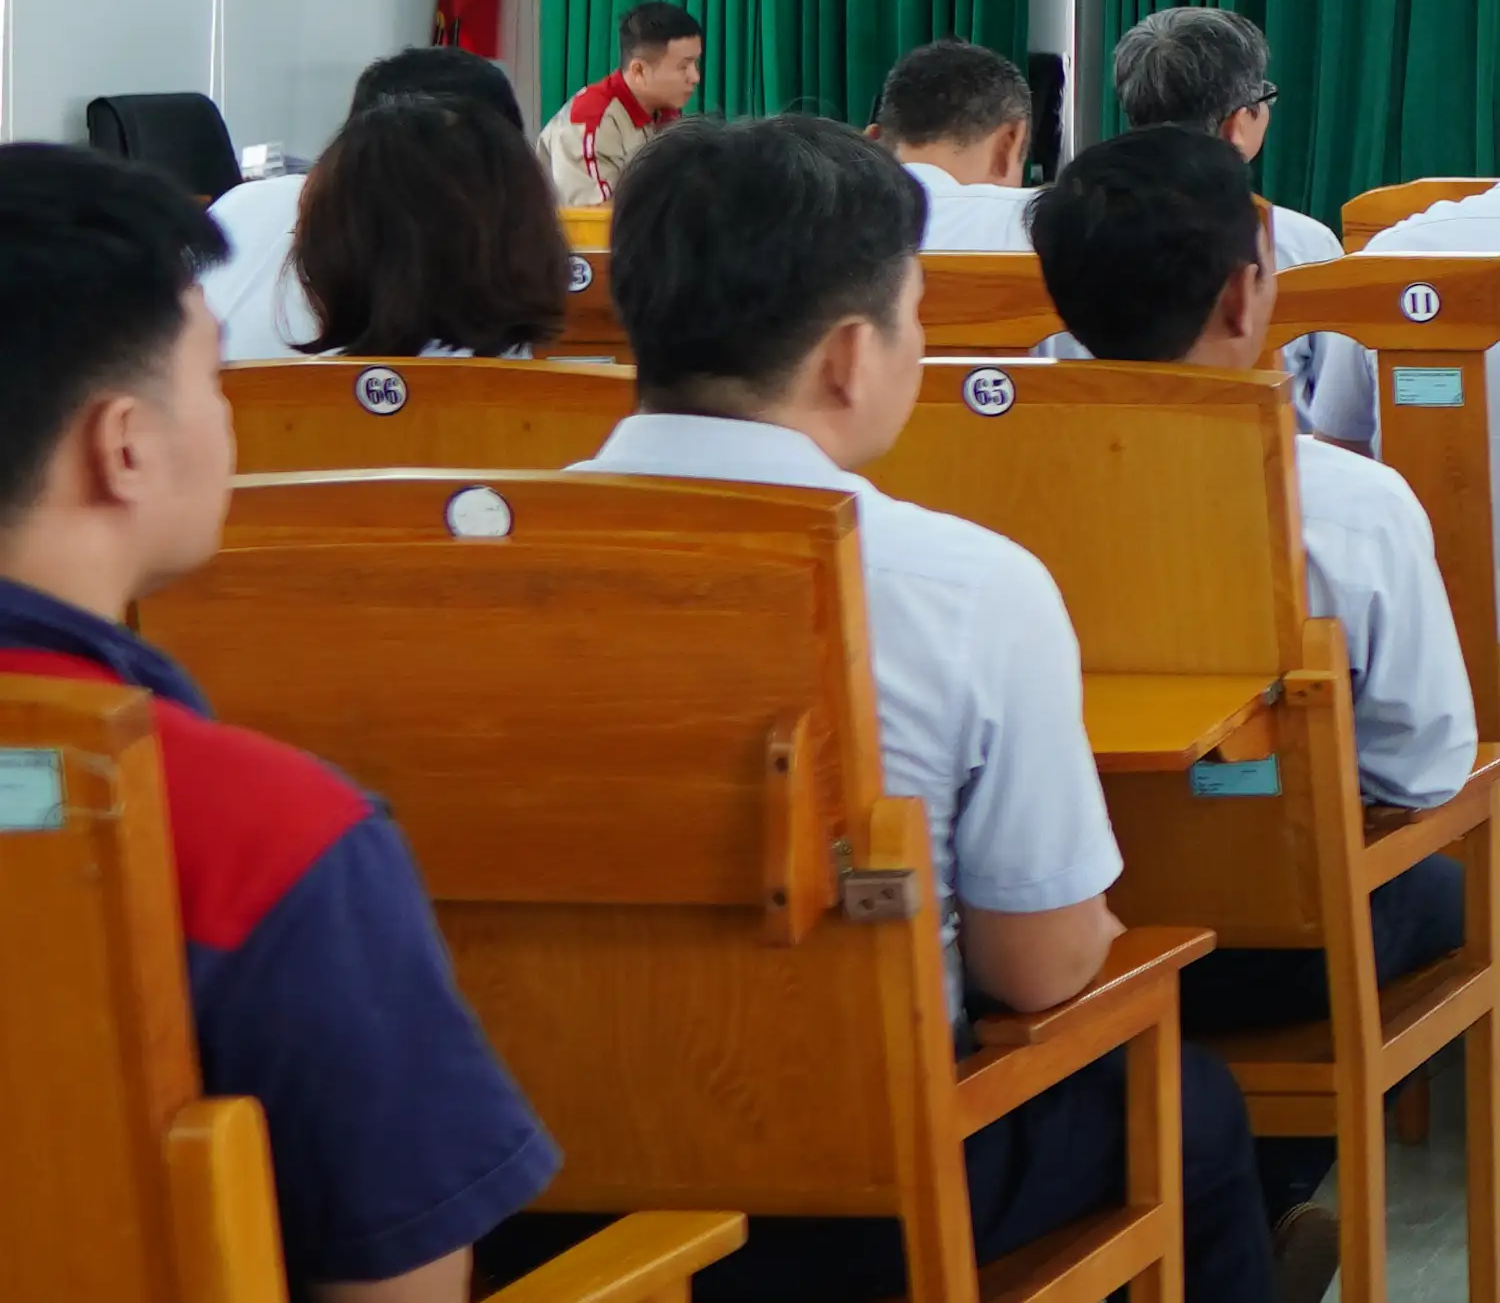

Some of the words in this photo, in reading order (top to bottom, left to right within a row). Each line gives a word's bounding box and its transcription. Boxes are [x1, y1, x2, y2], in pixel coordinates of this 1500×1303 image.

[1410, 292, 1434, 314] 11
[364, 376, 402, 406] 66
[972, 377, 1007, 406] 65
